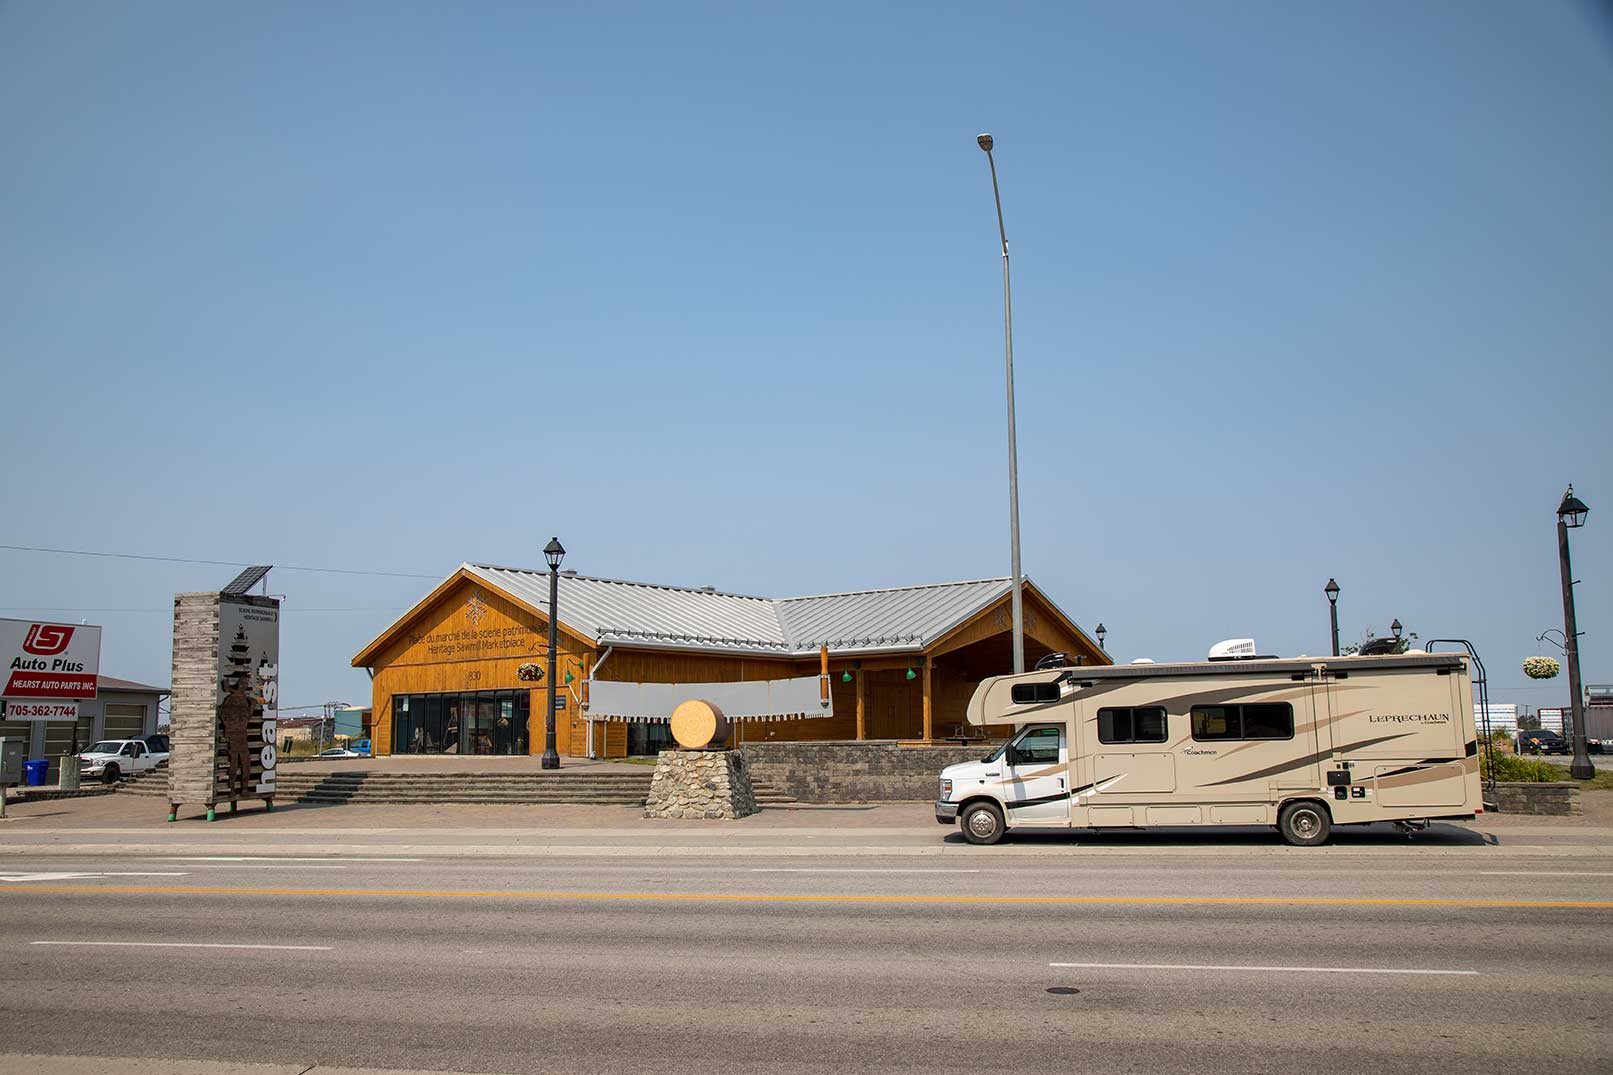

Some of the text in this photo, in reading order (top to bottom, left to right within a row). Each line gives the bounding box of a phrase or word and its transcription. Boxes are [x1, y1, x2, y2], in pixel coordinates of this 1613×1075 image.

[436, 631, 460, 642] marché
[461, 630, 470, 640] de
[471, 629, 477, 639] la
[479, 628, 501, 638] scierie
[502, 624, 549, 638] patrimoale
[428, 638, 525, 655] Heritage Sawmill Marketplace
[10, 656, 84, 672] Auto Plus
[12, 680, 95, 690] HEARST AUTO PARTS INC.
[9, 704, 77, 717] 705-362-7744
[1369, 713, 1450, 723] LEPRECHAUN
[256, 663, 278, 793] hearst
